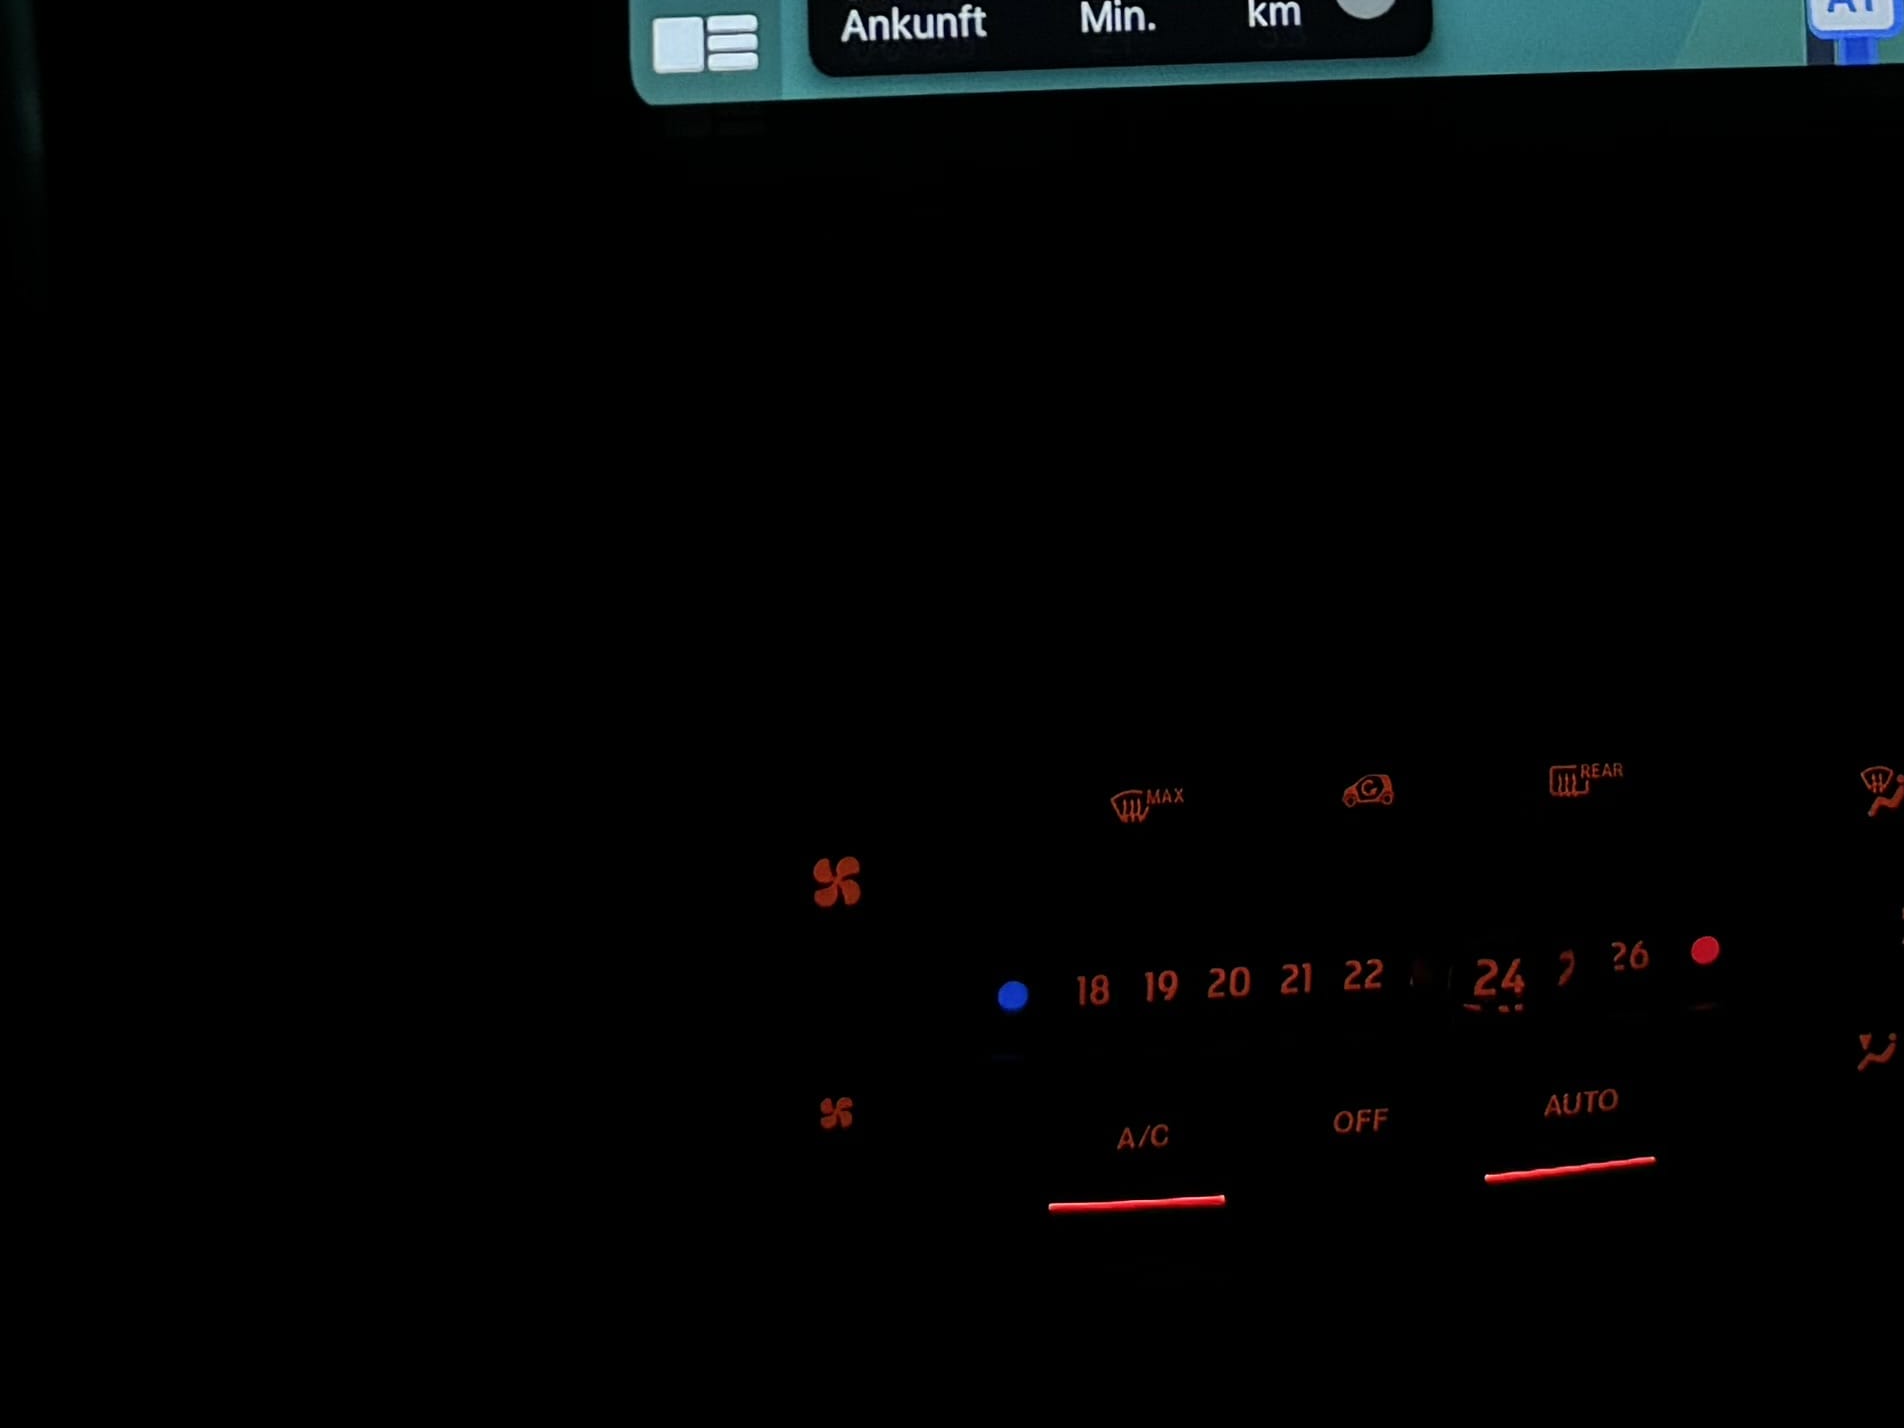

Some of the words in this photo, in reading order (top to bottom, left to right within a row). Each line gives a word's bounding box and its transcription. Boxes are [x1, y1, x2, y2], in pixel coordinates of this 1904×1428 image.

[840, 3, 988, 44] Ankunft
[1579, 761, 1625, 780] REAR
[1145, 787, 1185, 807] MAX
[1074, 971, 1113, 1011] 18
[1140, 967, 1185, 1006] 19
[1204, 964, 1253, 1002] 20
[1279, 960, 1314, 999] 21
[1342, 955, 1386, 994] 22
[1472, 955, 1528, 1001] 24
[1542, 1087, 1621, 1120] AUTO
[1115, 1121, 1172, 1153] A/C
[1331, 1106, 1393, 1137] OFF
